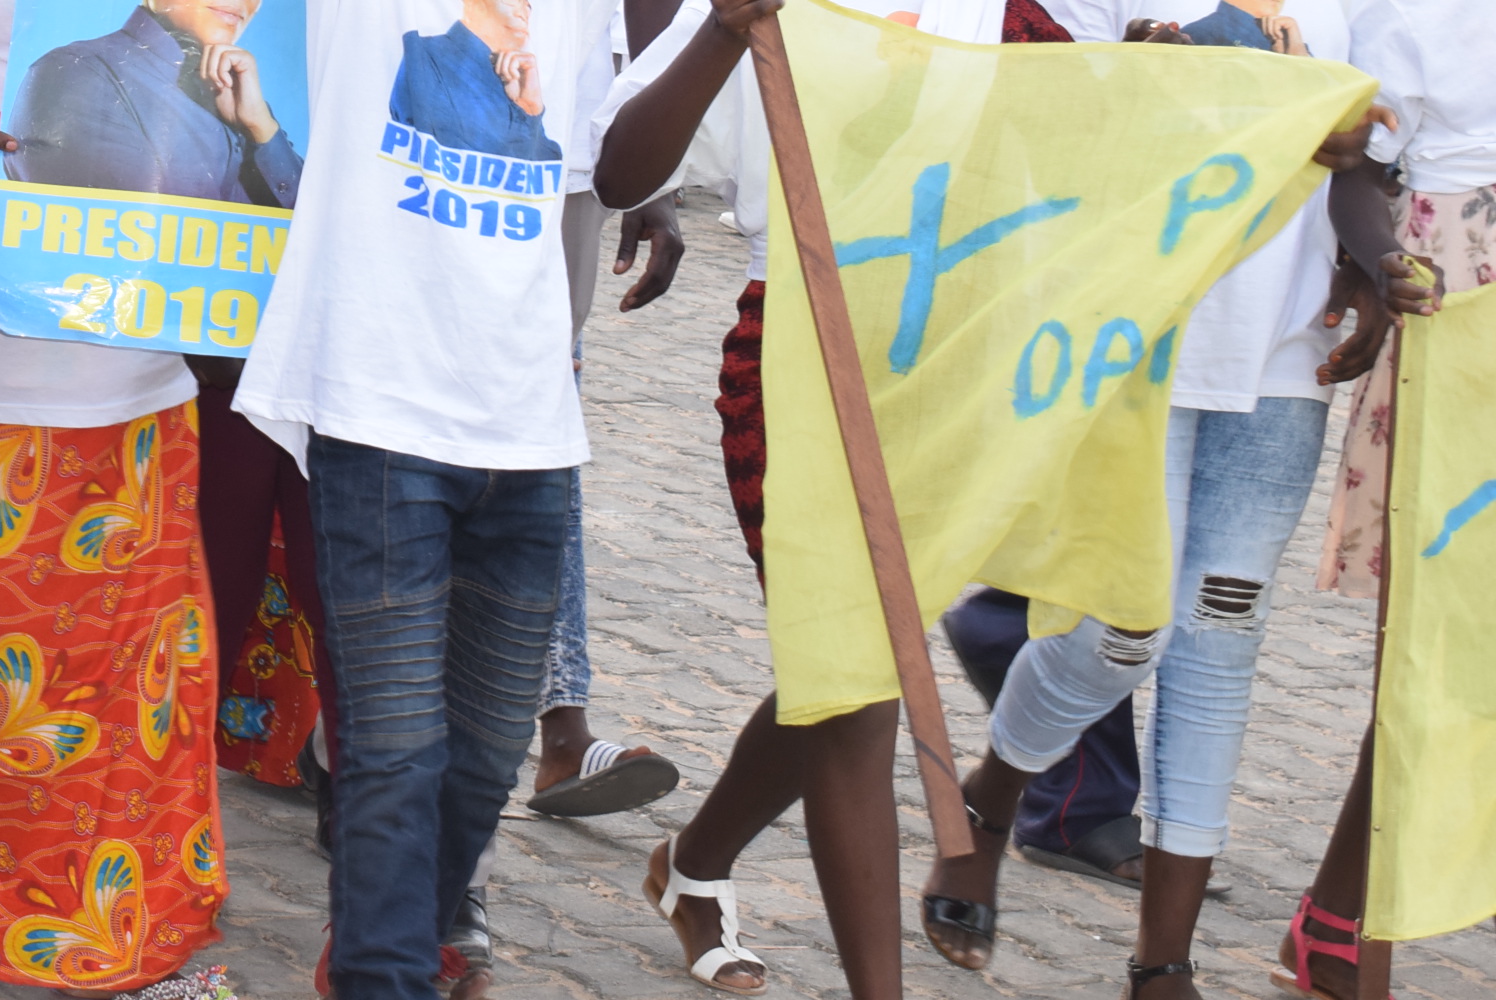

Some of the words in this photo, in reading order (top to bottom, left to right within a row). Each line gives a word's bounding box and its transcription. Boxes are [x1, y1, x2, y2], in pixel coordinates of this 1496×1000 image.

[2, 200, 289, 275] PRESIDEN
[398, 175, 542, 241] 2019
[59, 273, 260, 348] 2019
